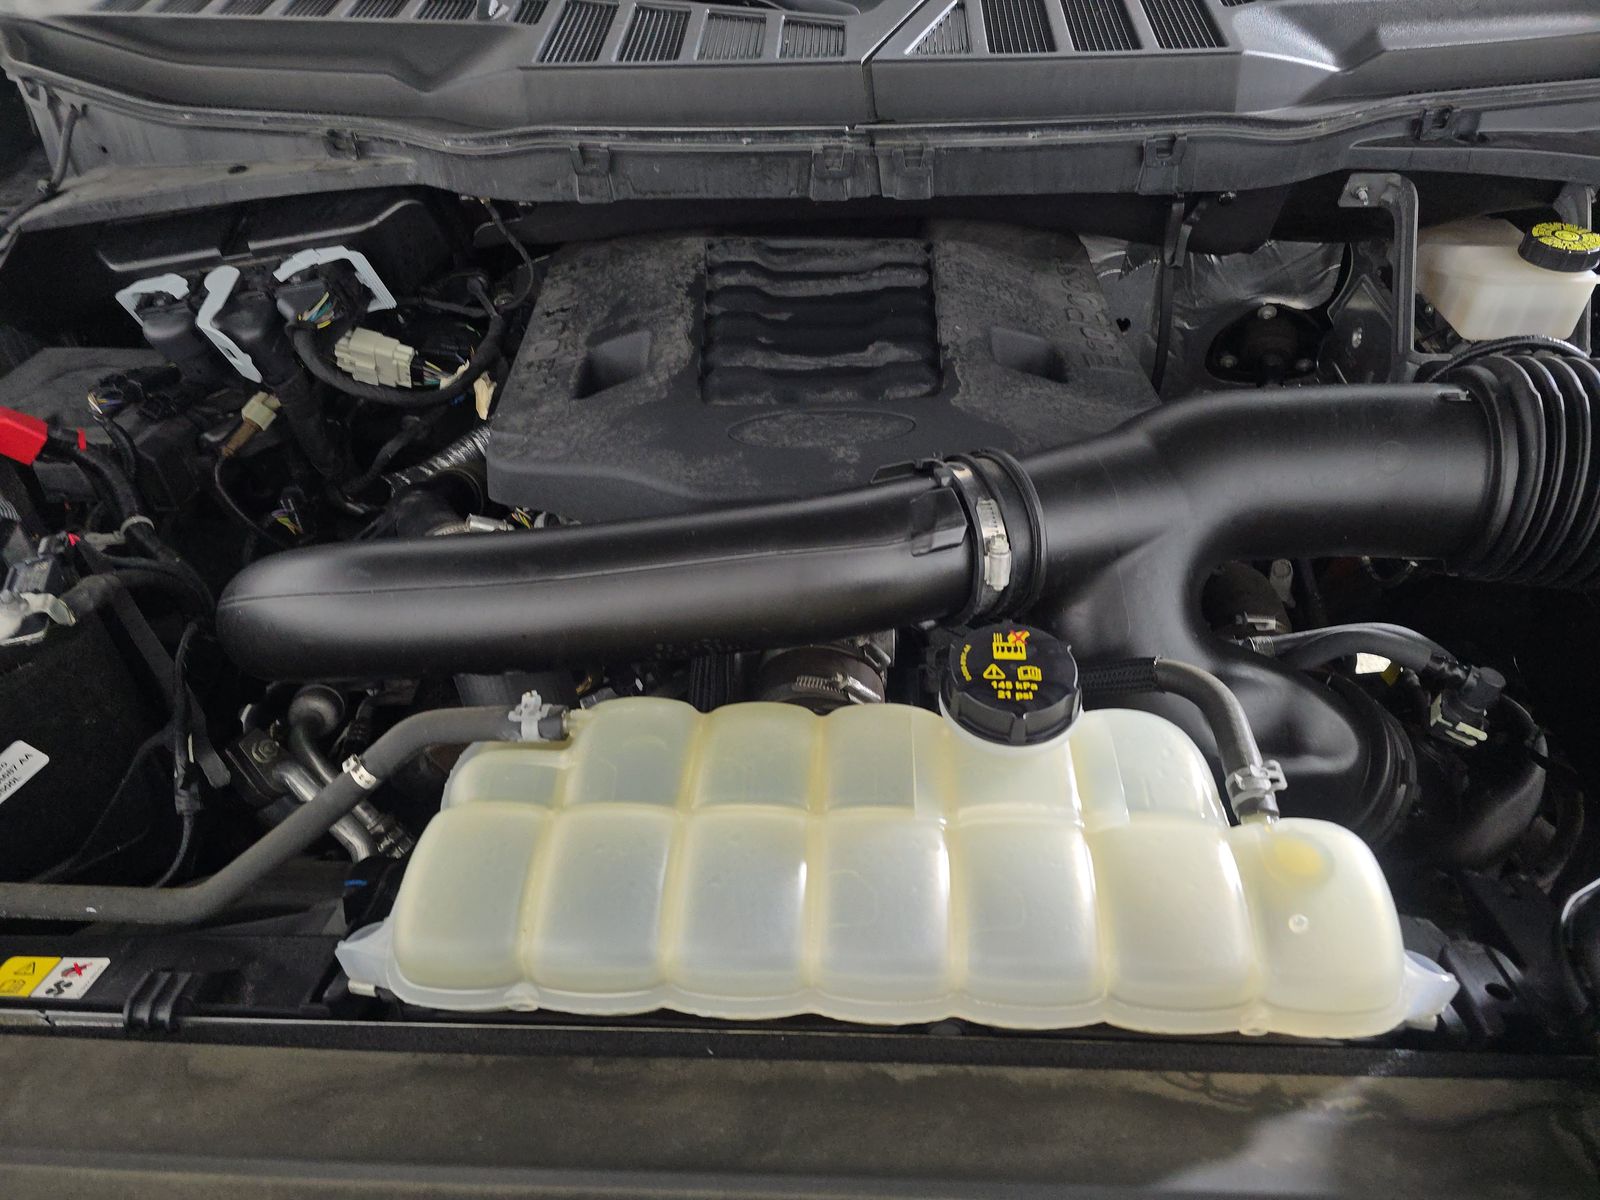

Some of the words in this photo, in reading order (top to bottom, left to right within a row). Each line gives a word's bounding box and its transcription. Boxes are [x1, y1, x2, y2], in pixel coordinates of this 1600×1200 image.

[1015, 680, 1039, 691] kPa
[997, 689, 1012, 699] 21
[1015, 690, 1034, 701] psi
